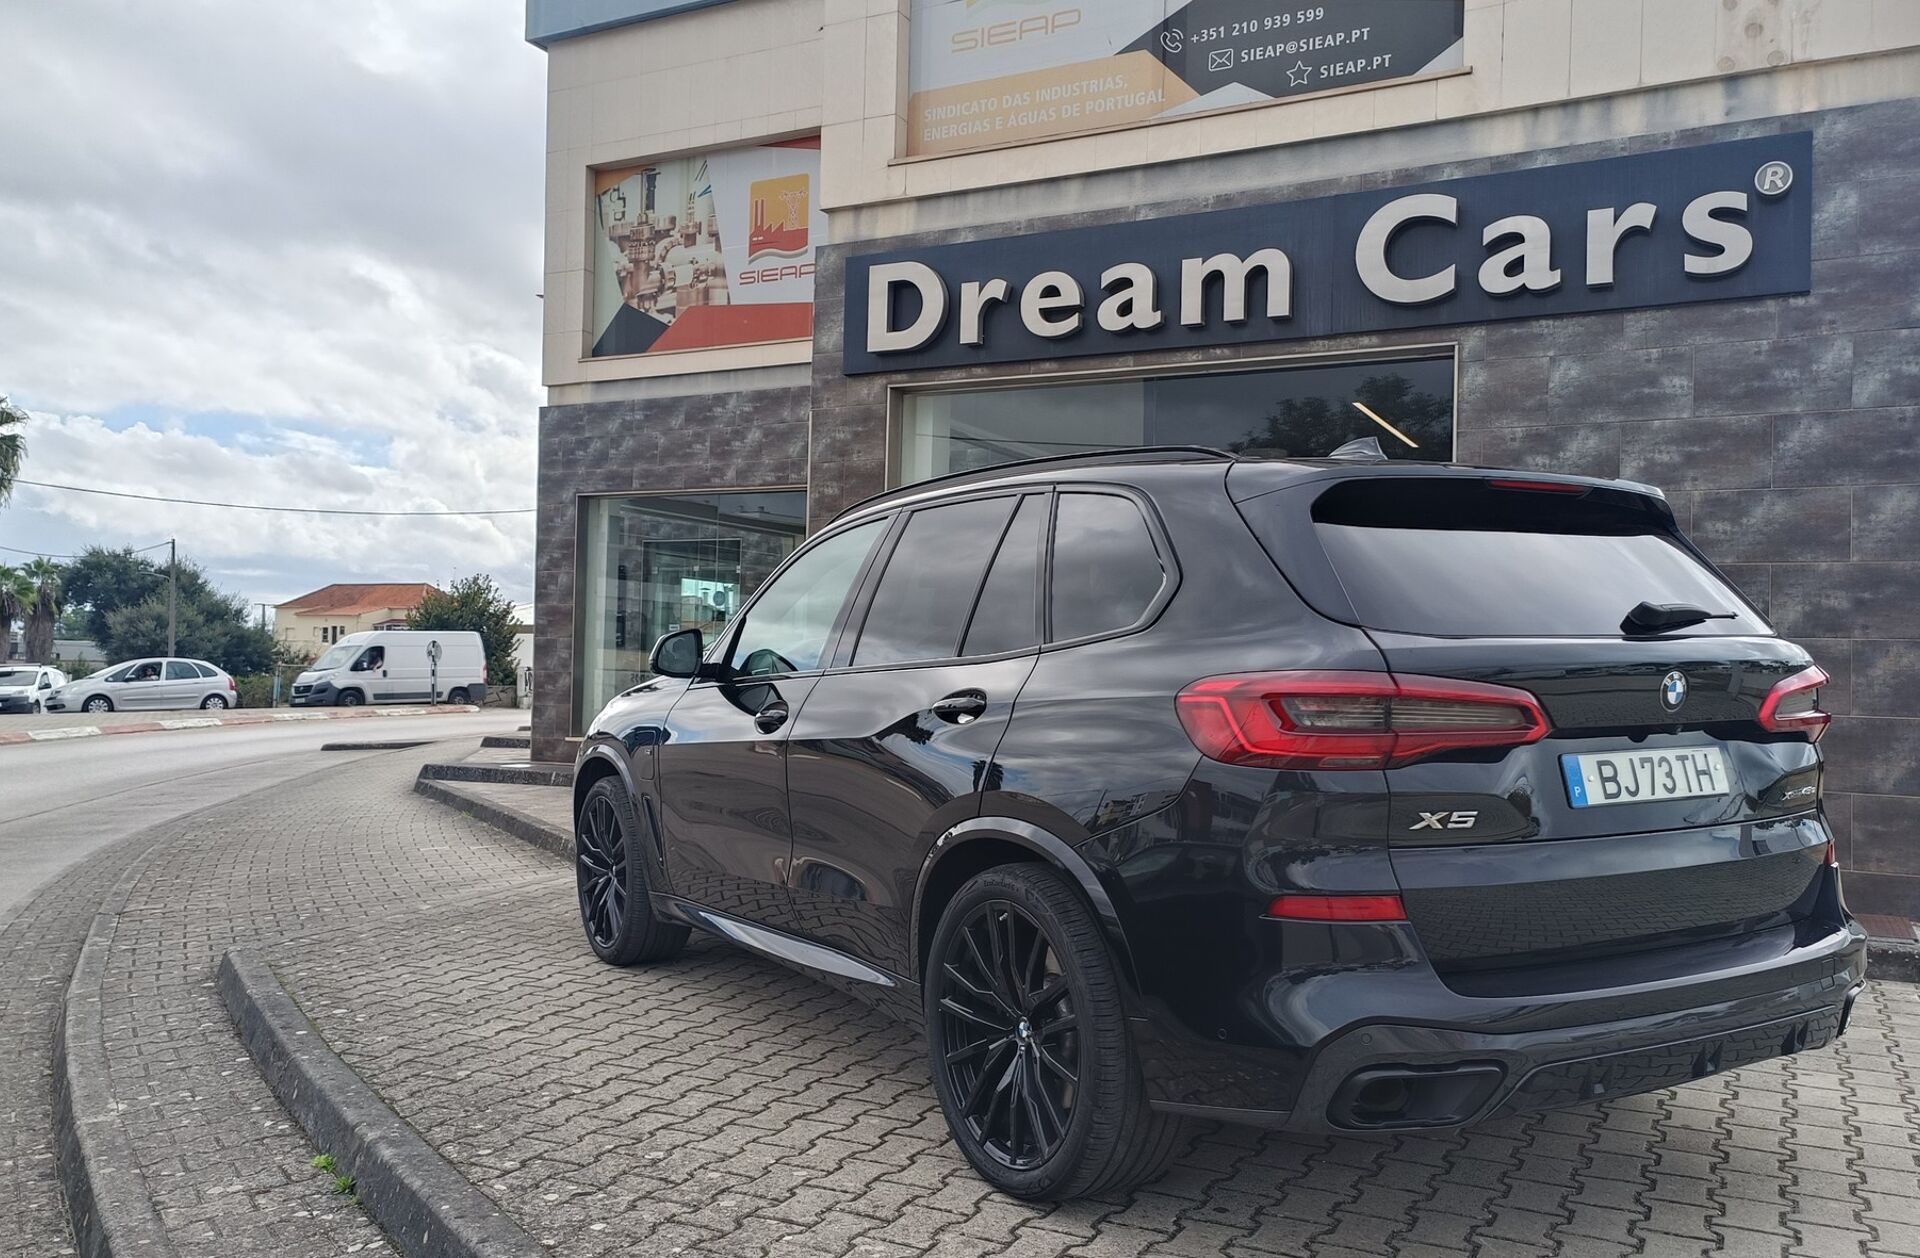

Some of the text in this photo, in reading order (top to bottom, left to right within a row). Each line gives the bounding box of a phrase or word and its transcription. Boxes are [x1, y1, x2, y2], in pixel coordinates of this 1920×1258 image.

[951, 8, 1081, 53] SIEAP
[1190, 7, 1324, 43] +351 210 939 599
[1240, 27, 1370, 63] SIEAP@SIEAP.PT
[1319, 54, 1392, 79] SIEAP.PT
[924, 97, 998, 122] SINDICATO
[1002, 91, 1031, 109] DAS
[924, 118, 990, 143] ENERGIAS
[995, 116, 1004, 129] E
[1061, 102, 1081, 119] DE
[1085, 88, 1167, 114] PORTUGAL
[739, 263, 816, 286] SIEAP
[867, 247, 1292, 353] Dream
[1574, 786, 1582, 798] P
[1596, 753, 1716, 800] BJ73TH
[1408, 811, 1479, 830] X5
